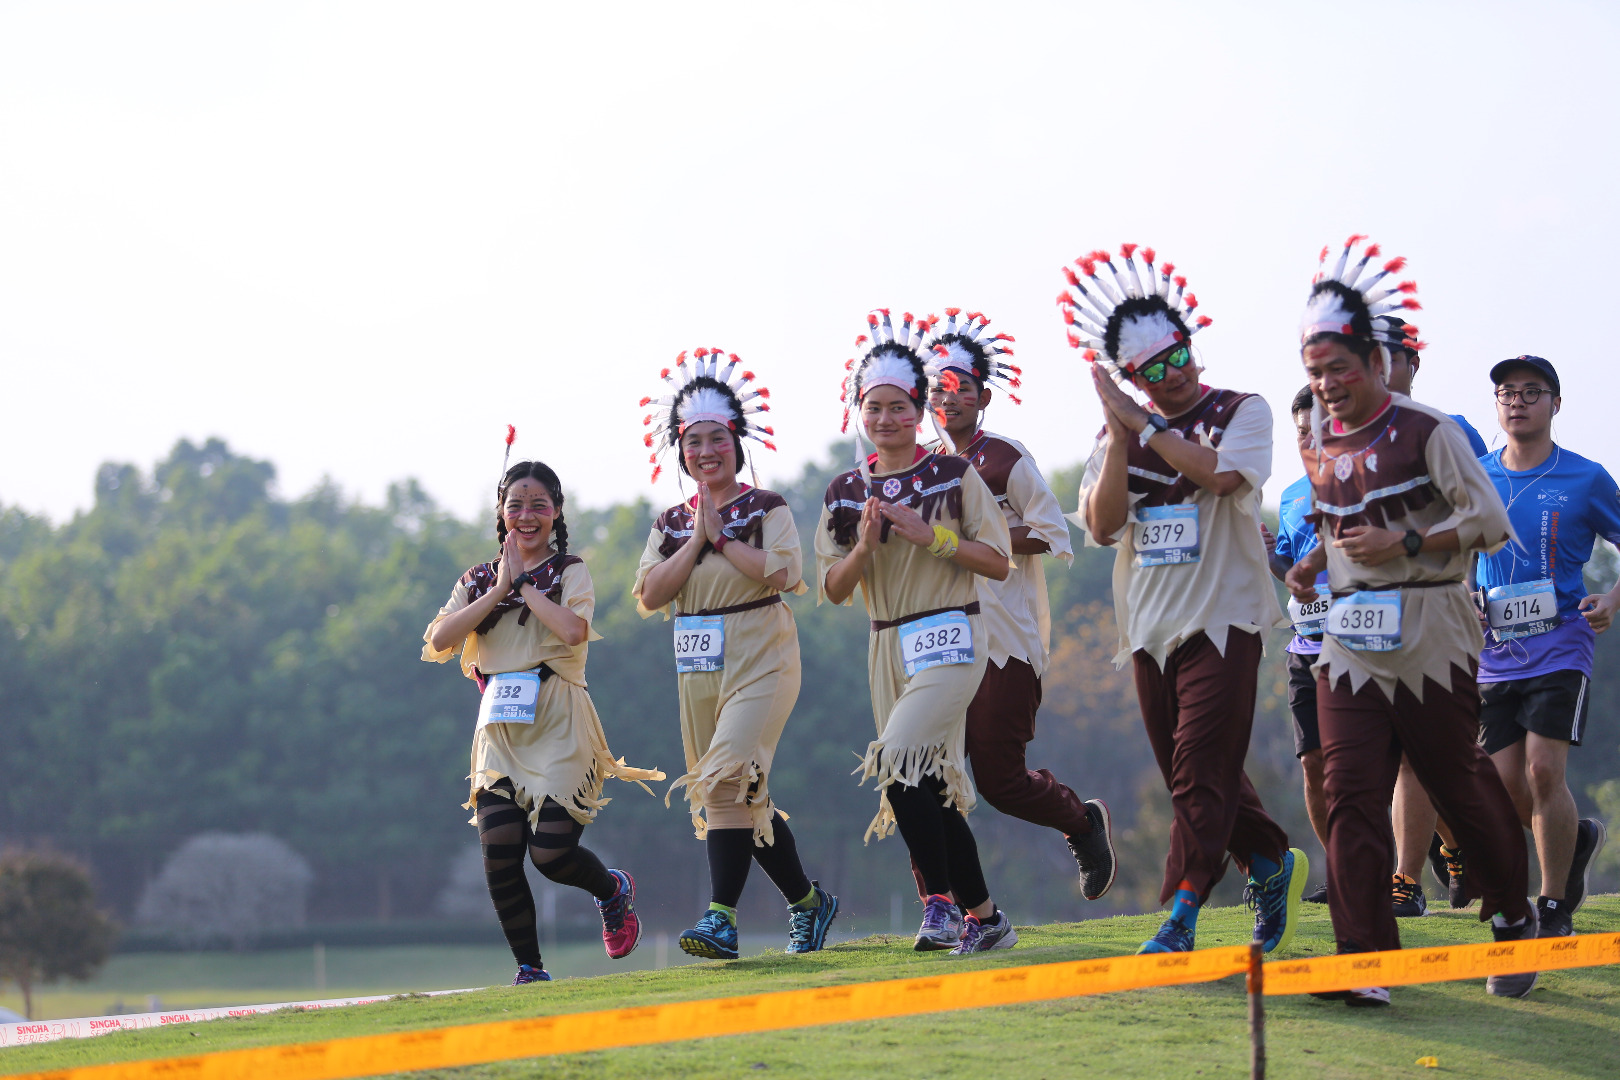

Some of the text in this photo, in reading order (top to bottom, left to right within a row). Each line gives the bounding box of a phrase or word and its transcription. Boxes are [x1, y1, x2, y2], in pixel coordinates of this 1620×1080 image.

[1541, 510, 1549, 536] CROSS
[1550, 511, 1559, 545] SINGHA
[1142, 523, 1184, 545] 6379
[1549, 546, 1557, 569] PARK
[1300, 600, 1329, 616] 6285
[1503, 598, 1541, 620] 6114
[1340, 609, 1384, 629] 6381
[676, 634, 711, 652] 6378
[914, 627, 961, 652] 6382
[491, 685, 522, 699] 332
[89, 1019, 121, 1029] SINGHA
[160, 1013, 191, 1024] SINGHA
[16, 1024, 50, 1035] SINGHA
[16, 1033, 50, 1043] SERIES
